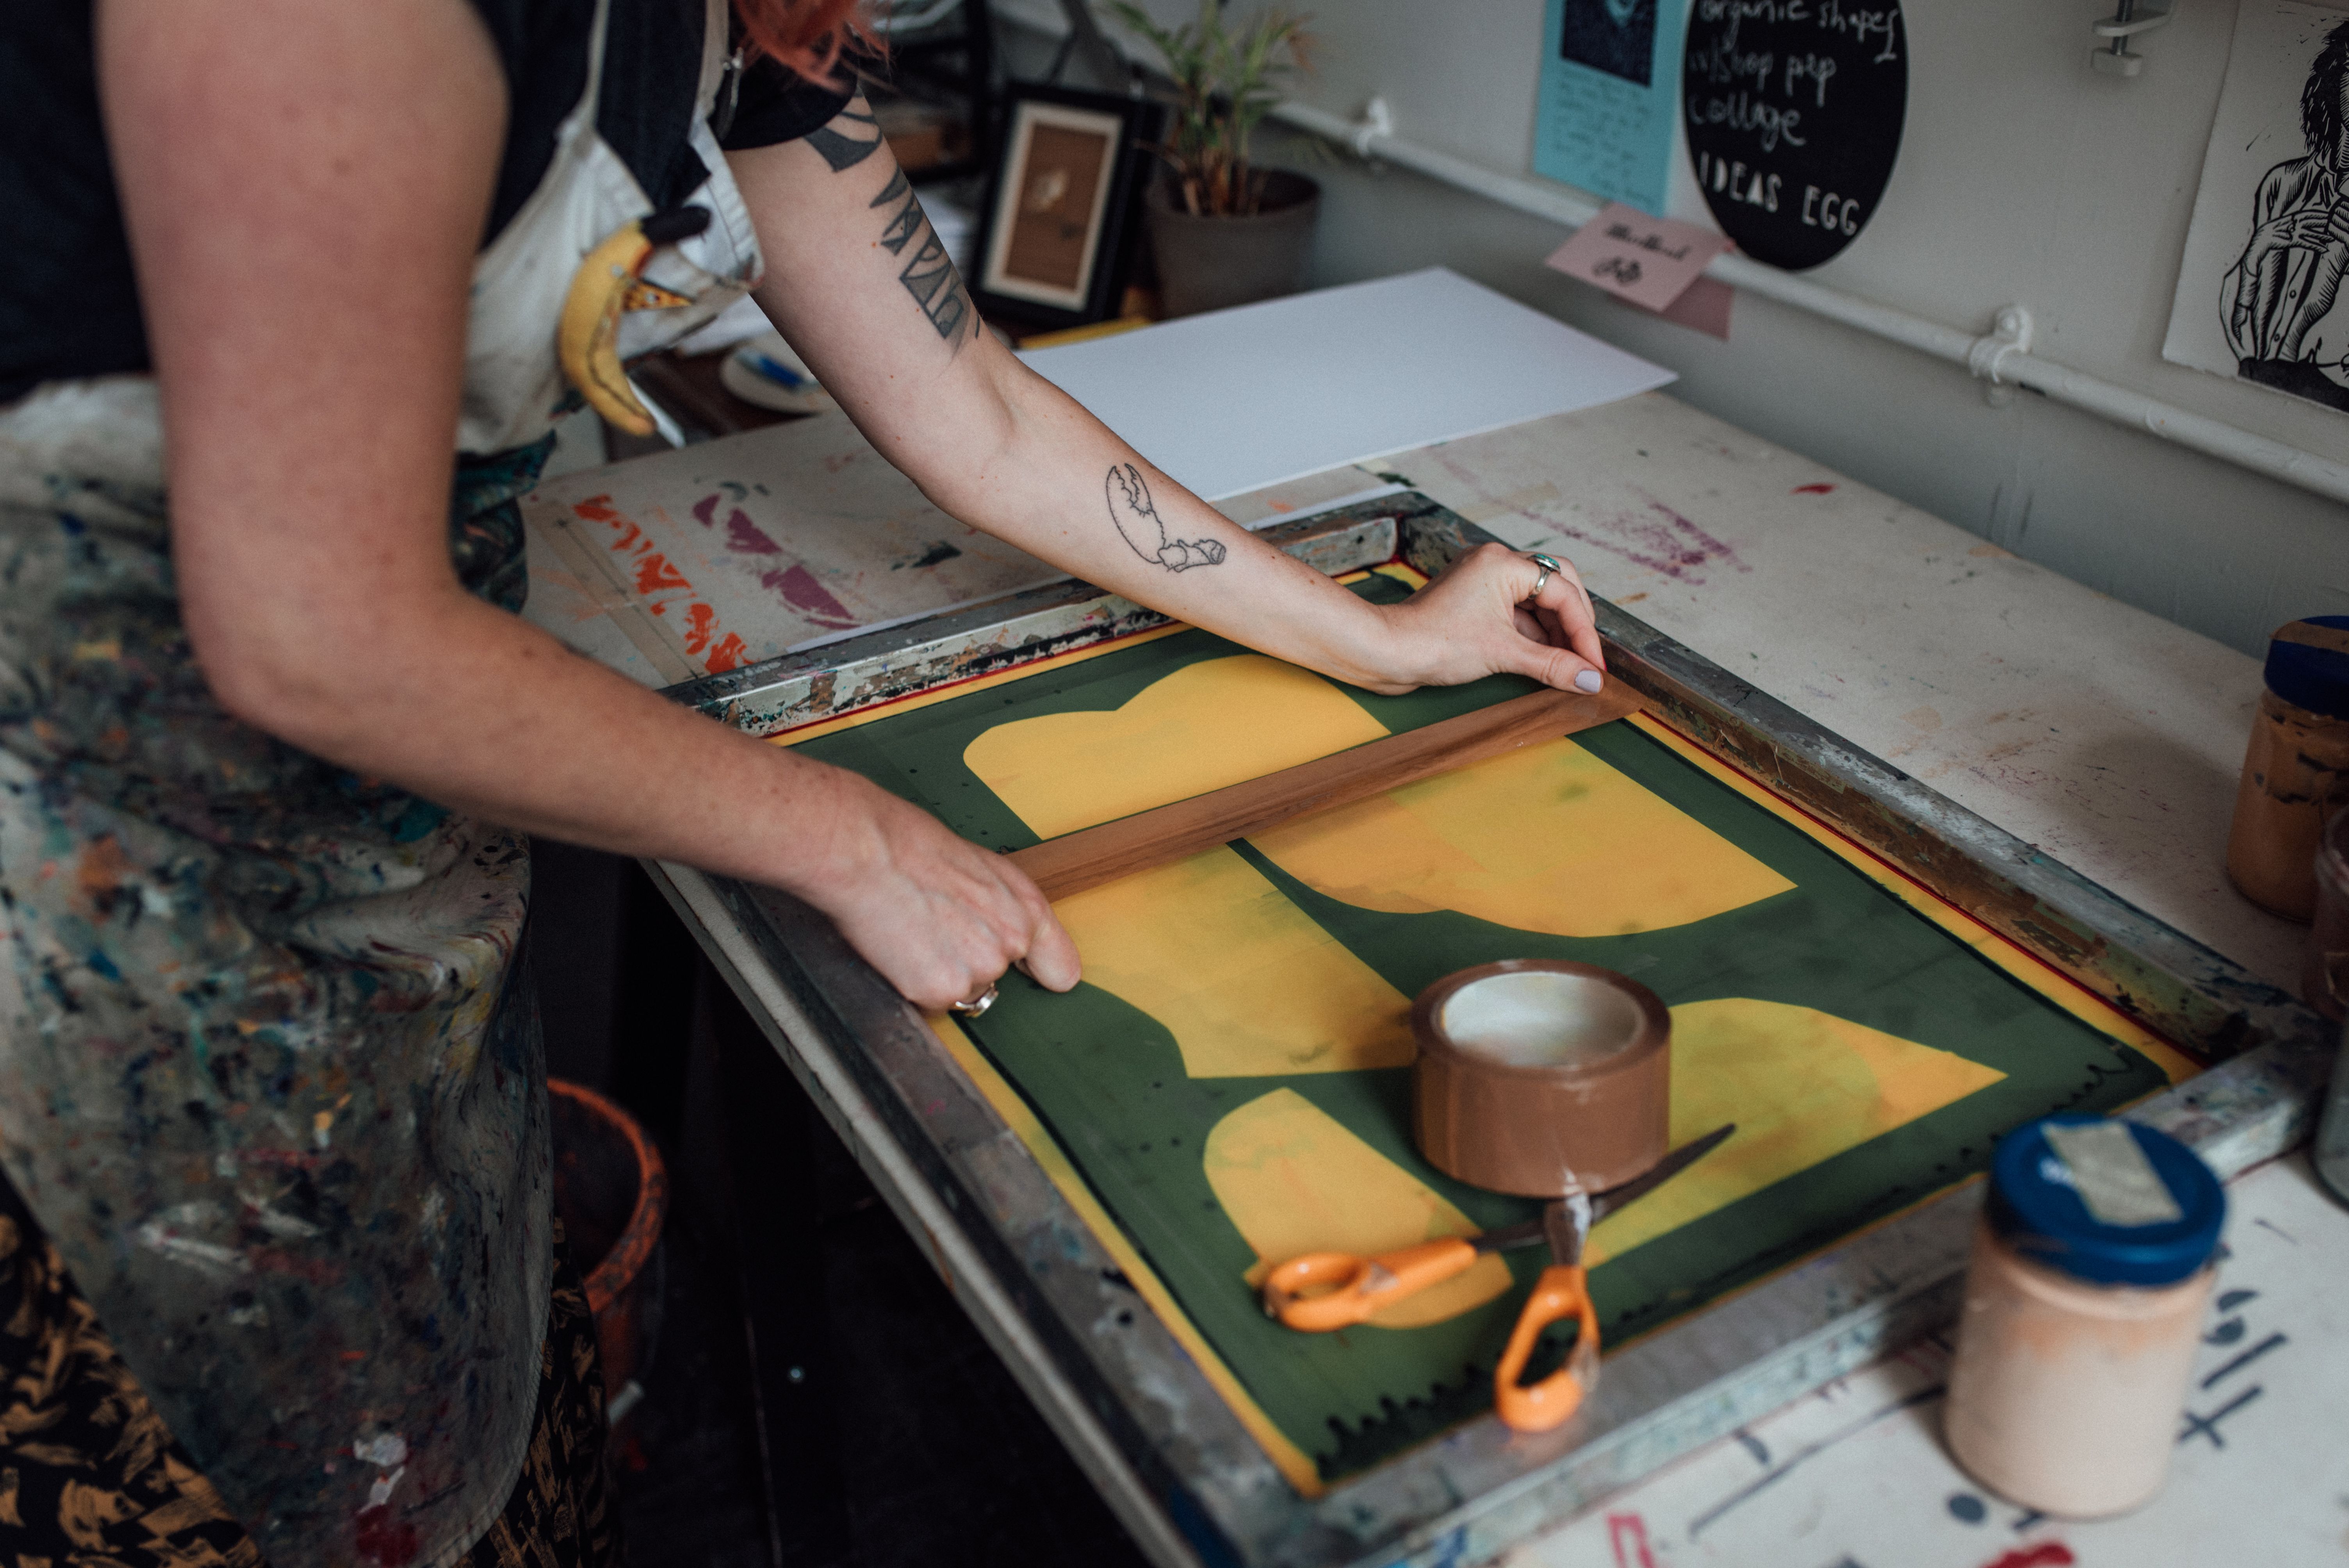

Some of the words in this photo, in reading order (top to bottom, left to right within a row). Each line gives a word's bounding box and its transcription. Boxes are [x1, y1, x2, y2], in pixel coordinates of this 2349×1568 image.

[1688, 90, 1807, 152] collage
[1700, 151, 1782, 213] IDEAS
[1802, 185, 1860, 235] EGG
